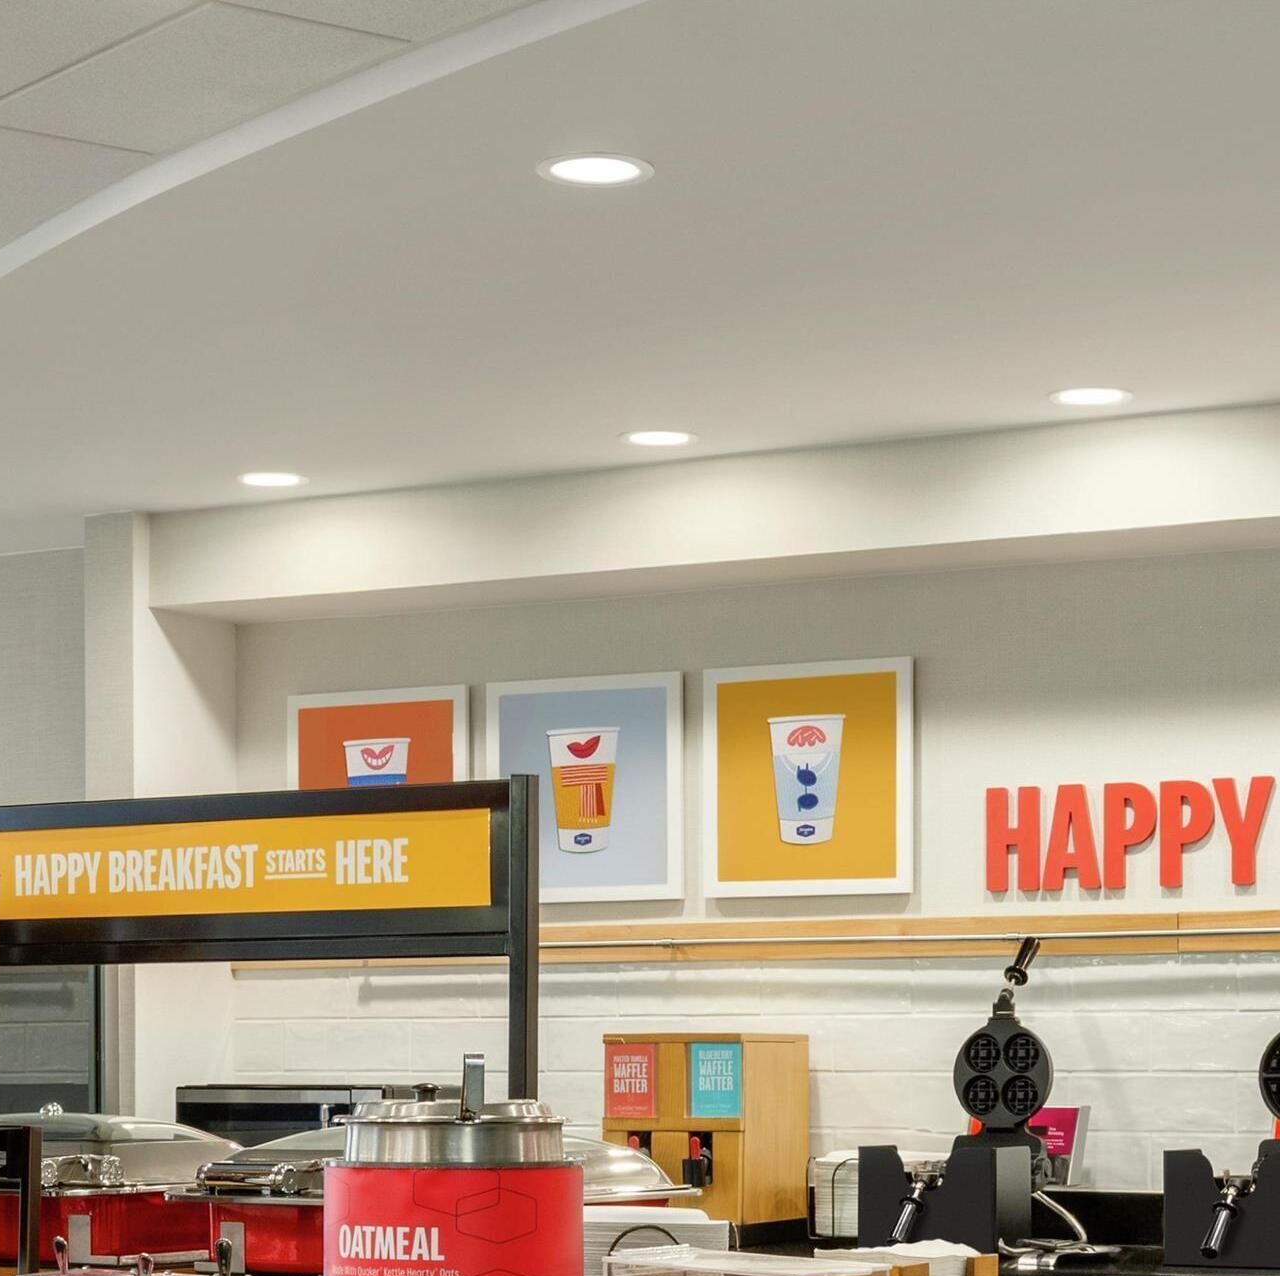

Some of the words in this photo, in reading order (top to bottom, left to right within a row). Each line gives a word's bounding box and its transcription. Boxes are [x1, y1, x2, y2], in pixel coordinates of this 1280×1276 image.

[986, 776, 1273, 892] HAPPY
[14, 852, 101, 896] HAPPY
[108, 844, 258, 893] BREAKFAST
[265, 848, 326, 874] STARTS
[335, 838, 409, 885] HERE
[613, 1063, 648, 1078] WAFFLE
[699, 1060, 734, 1076] WAFFLE
[613, 1079, 648, 1093] BATTER
[699, 1076, 734, 1091] BATTER
[339, 1224, 446, 1261] OATMEAL
